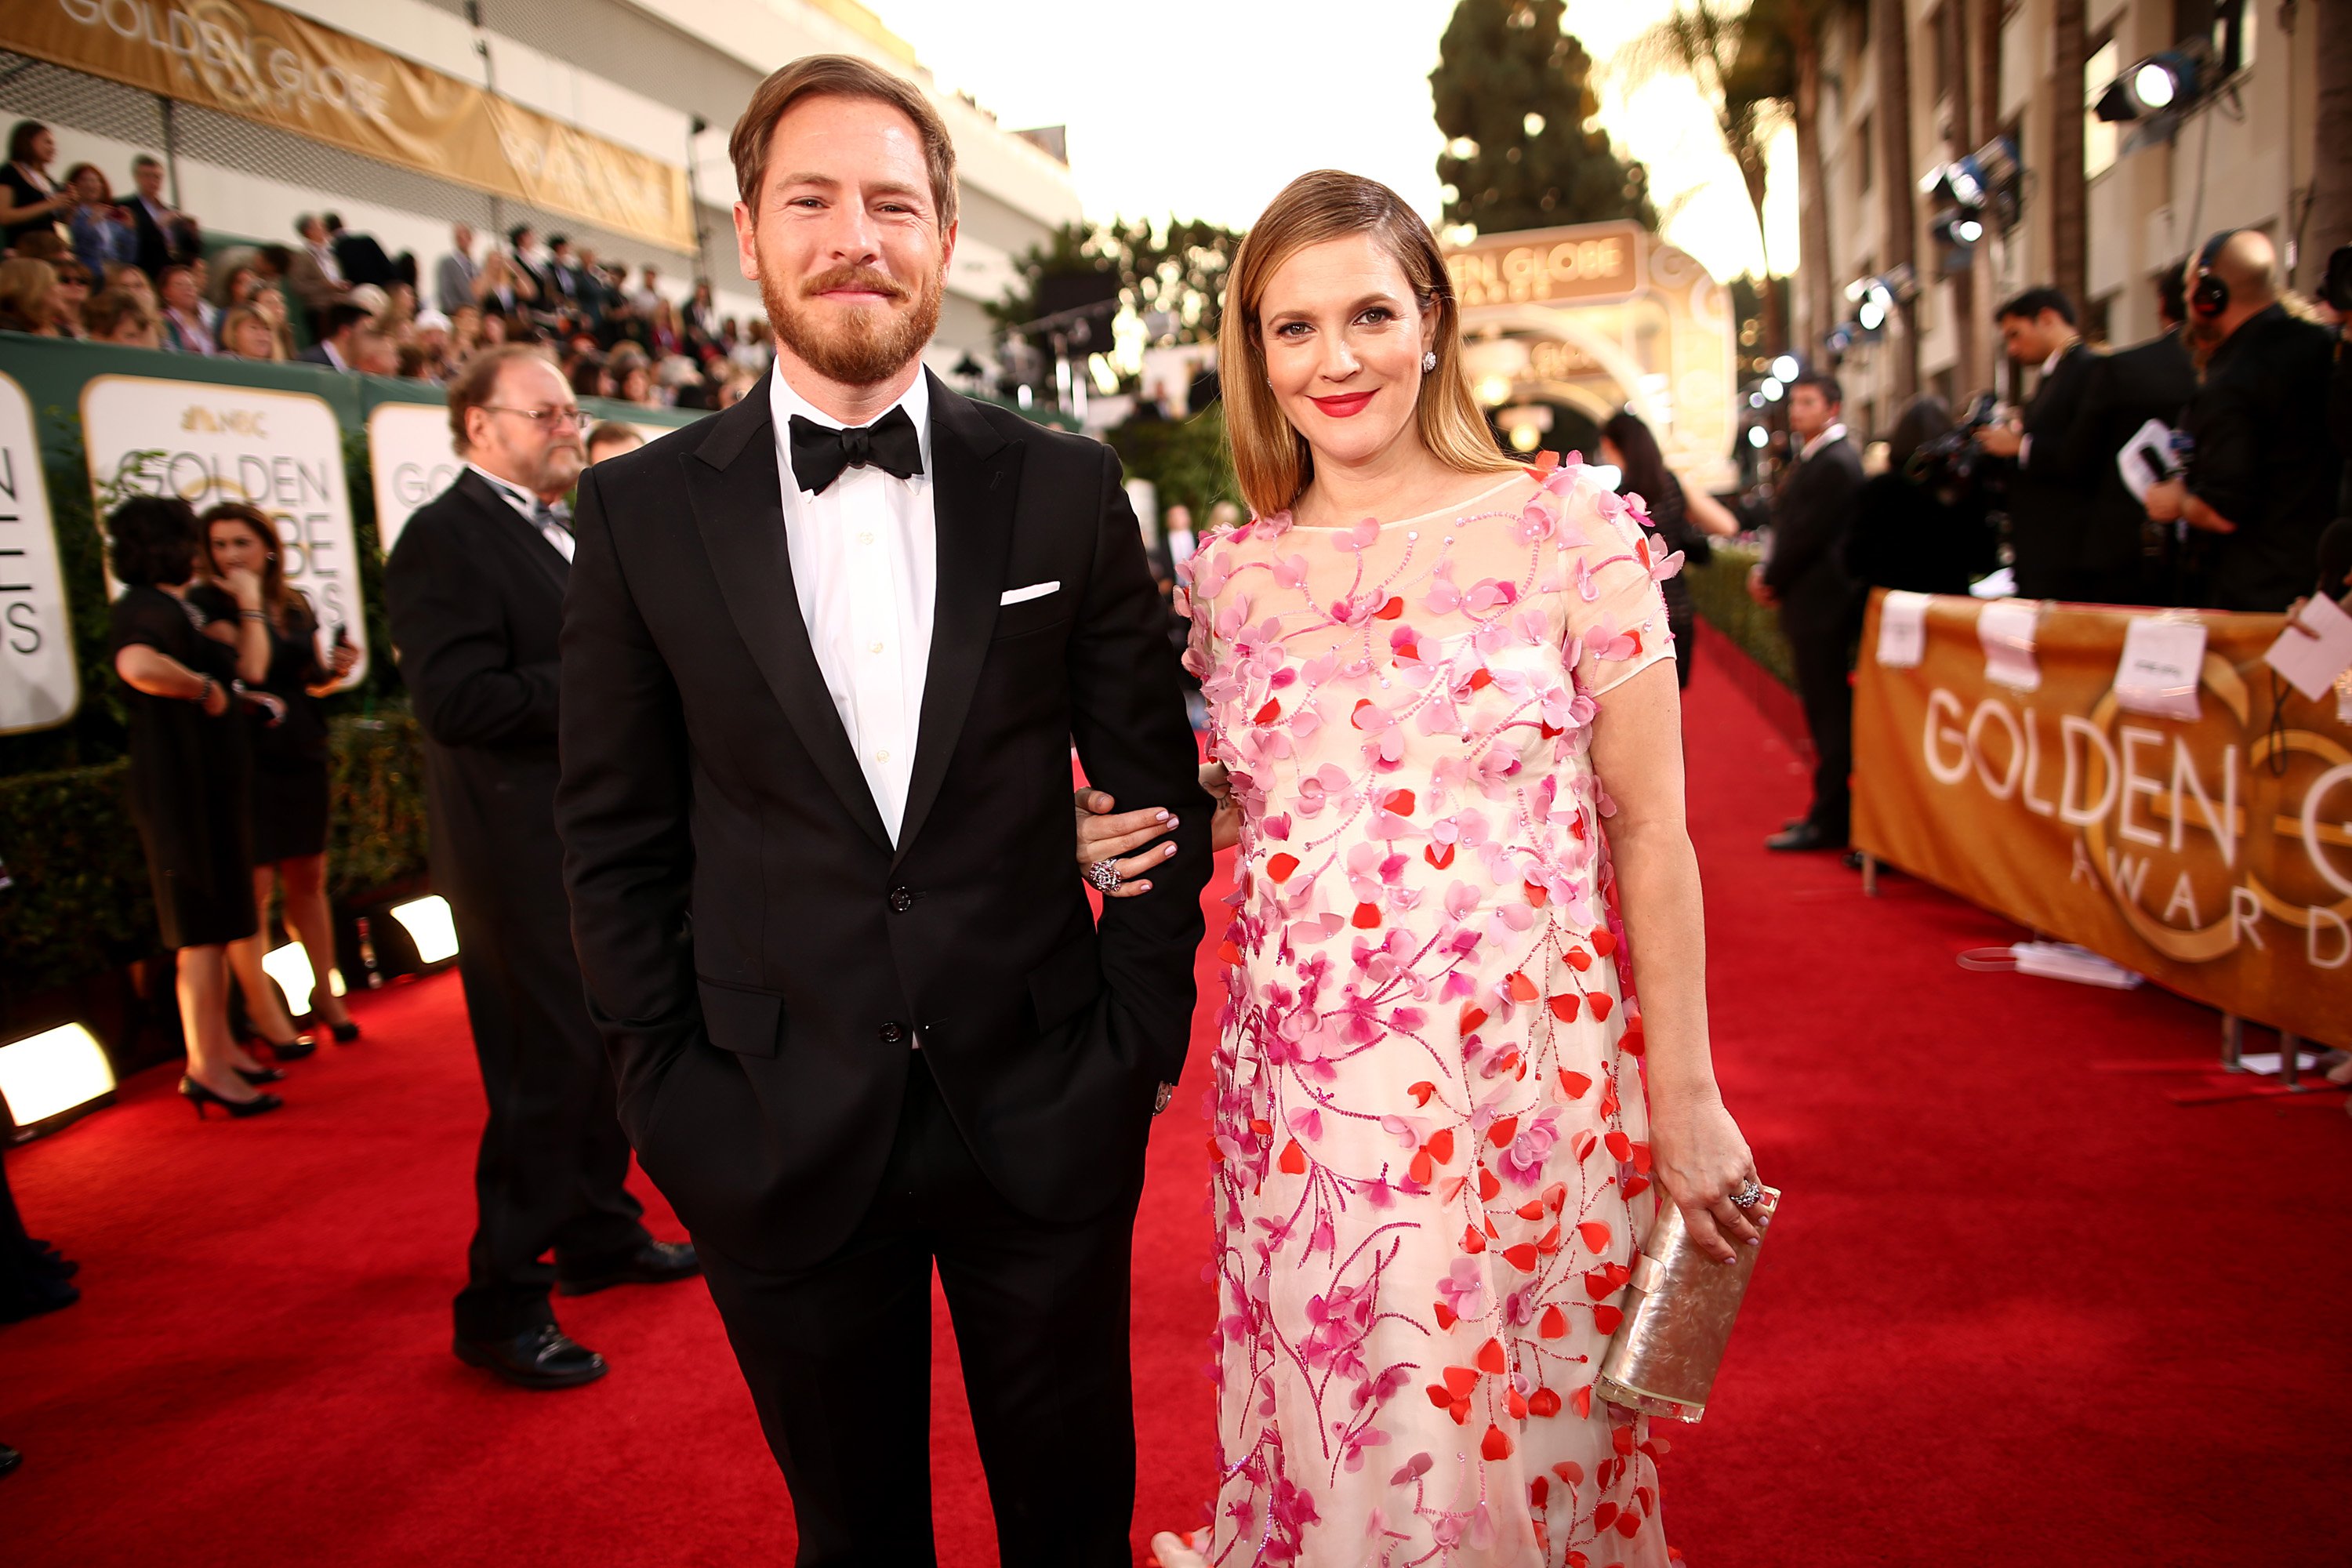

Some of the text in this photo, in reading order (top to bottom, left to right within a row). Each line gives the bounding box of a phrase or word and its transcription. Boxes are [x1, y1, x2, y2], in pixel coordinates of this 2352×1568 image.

[1502, 237, 1624, 285] GLOBE
[220, 411, 269, 439] NBC
[119, 447, 332, 507] GOLDEN
[1922, 688, 2238, 869] GOLDEN
